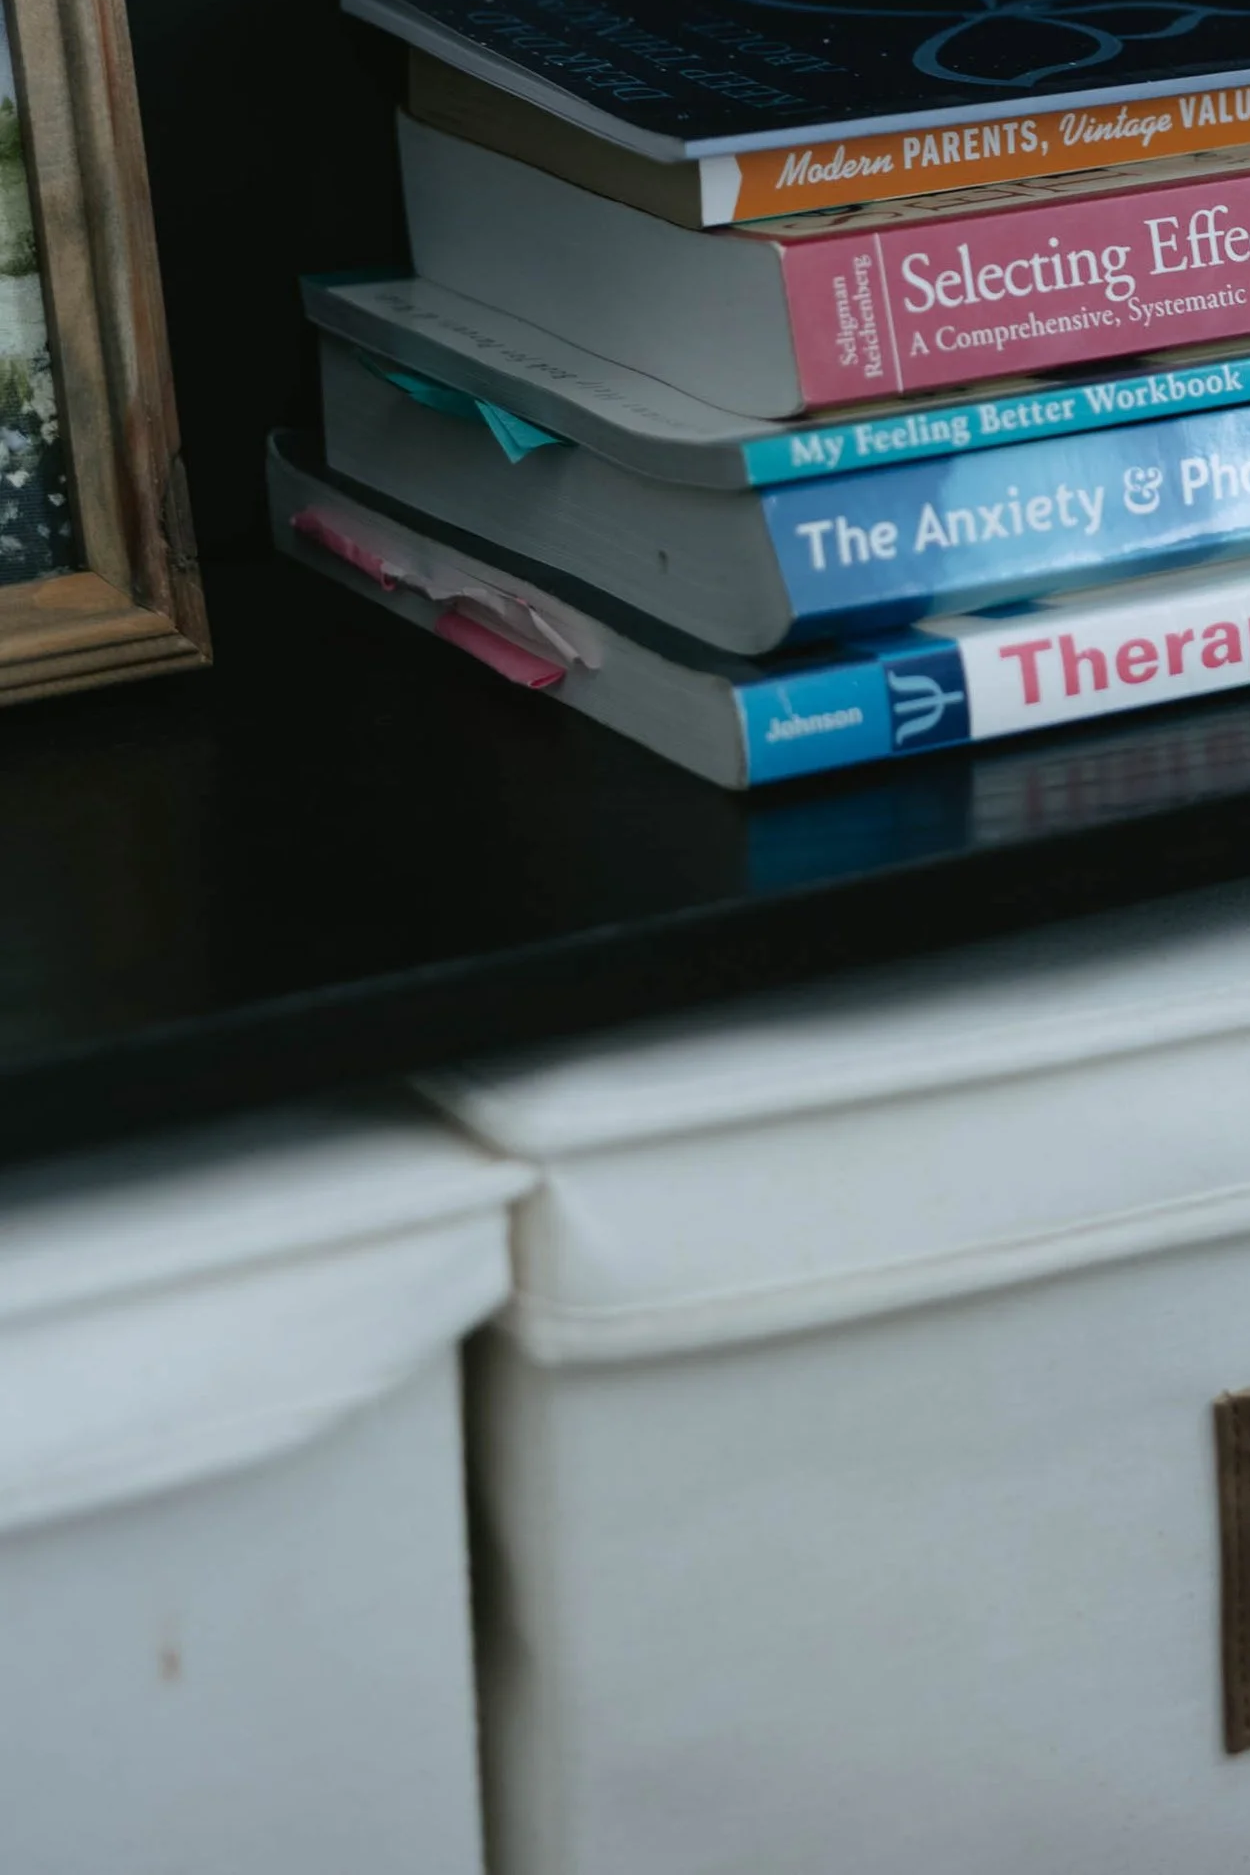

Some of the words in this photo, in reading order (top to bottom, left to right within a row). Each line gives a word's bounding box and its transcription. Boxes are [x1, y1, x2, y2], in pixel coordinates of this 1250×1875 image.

[776, 145, 893, 190] Modern
[903, 119, 1048, 170] PARENTS,
[1060, 104, 1171, 150] Vintage
[851, 254, 883, 379] Reichenberg
[901, 235, 1133, 313] Selecting
[833, 275, 859, 367] Seligman
[909, 329, 930, 357] A
[935, 303, 1121, 352] Comprehensive,
[1127, 283, 1247, 327] Systematic
[789, 429, 843, 469] My
[855, 409, 971, 457] Feeling
[979, 393, 1075, 433] Better
[1082, 360, 1244, 414] Workbook
[796, 519, 898, 572] The
[915, 485, 1105, 555] Anxiety
[1122, 465, 1162, 514] &
[765, 706, 864, 743] Johnson
